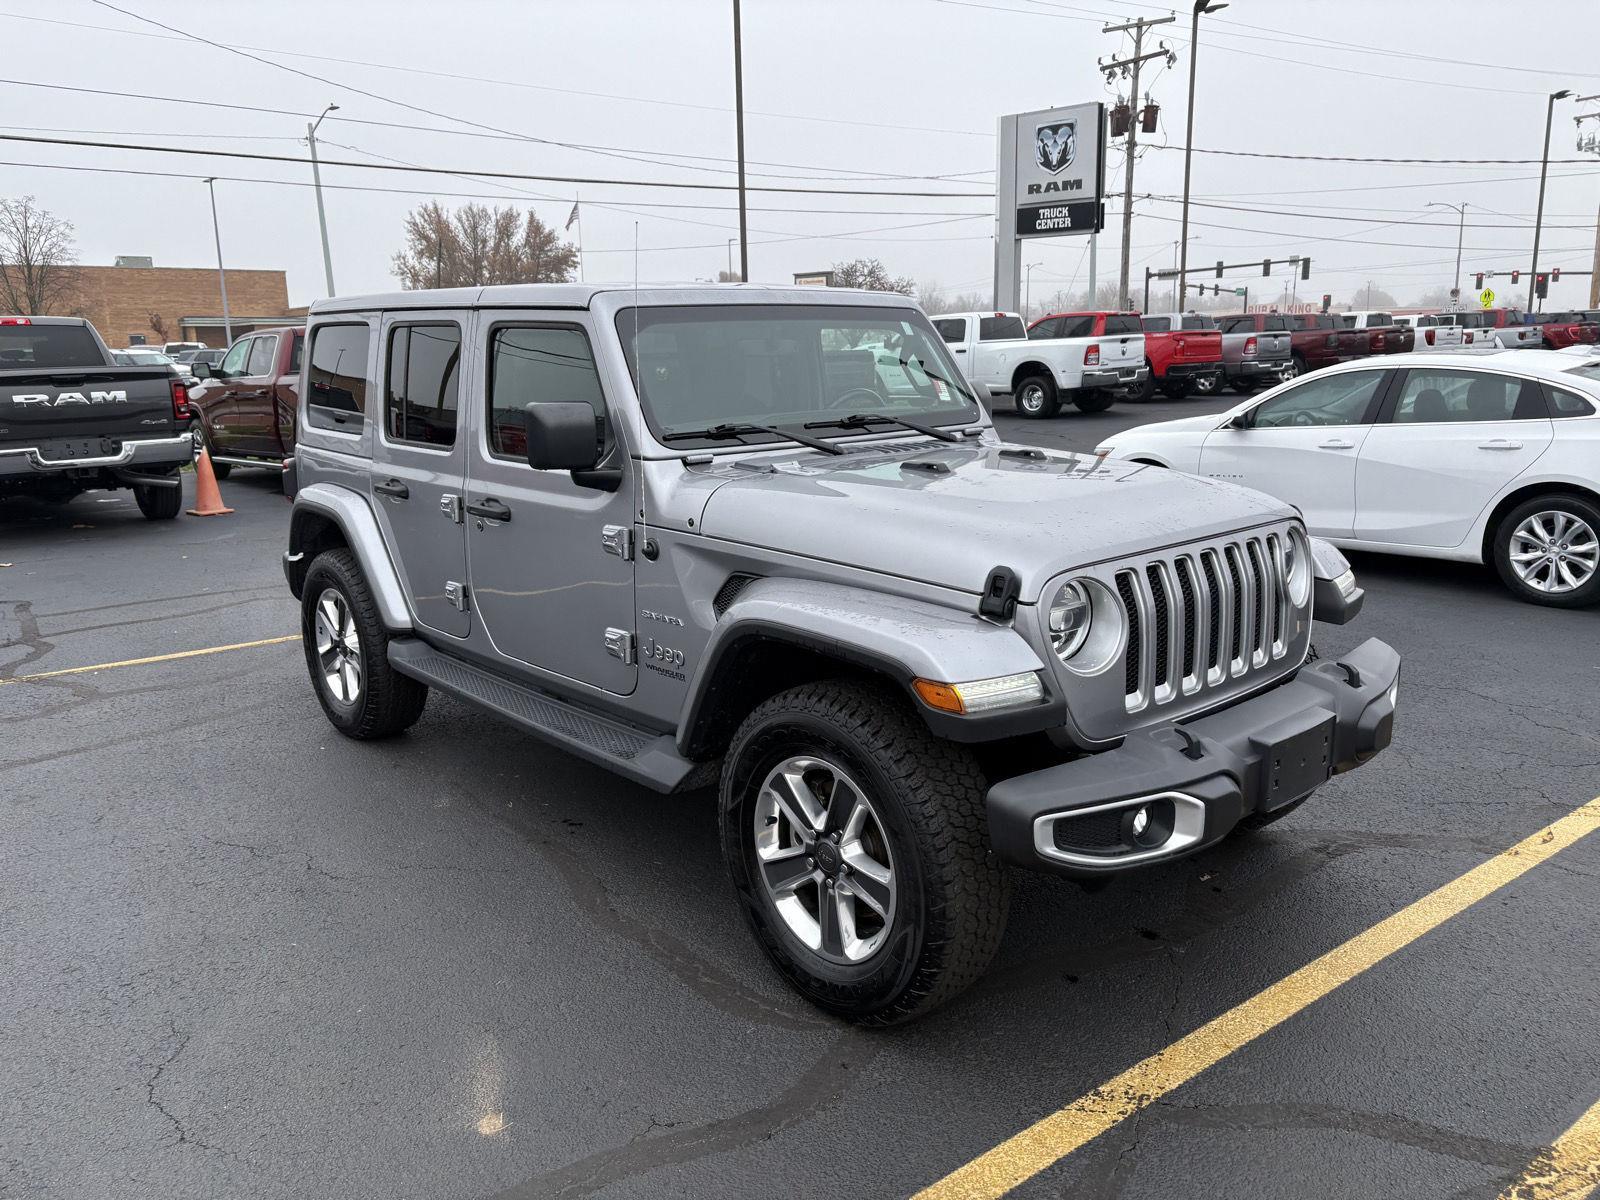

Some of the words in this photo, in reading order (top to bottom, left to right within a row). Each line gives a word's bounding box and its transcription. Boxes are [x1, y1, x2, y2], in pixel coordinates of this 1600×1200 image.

[1027, 178, 1083, 195] RAM
[1038, 206, 1069, 219] TRUCK
[1035, 217, 1072, 230] CENTER
[1287, 303, 1312, 314] KING
[12, 390, 128, 407] RAM
[642, 637, 686, 669] Jeep
